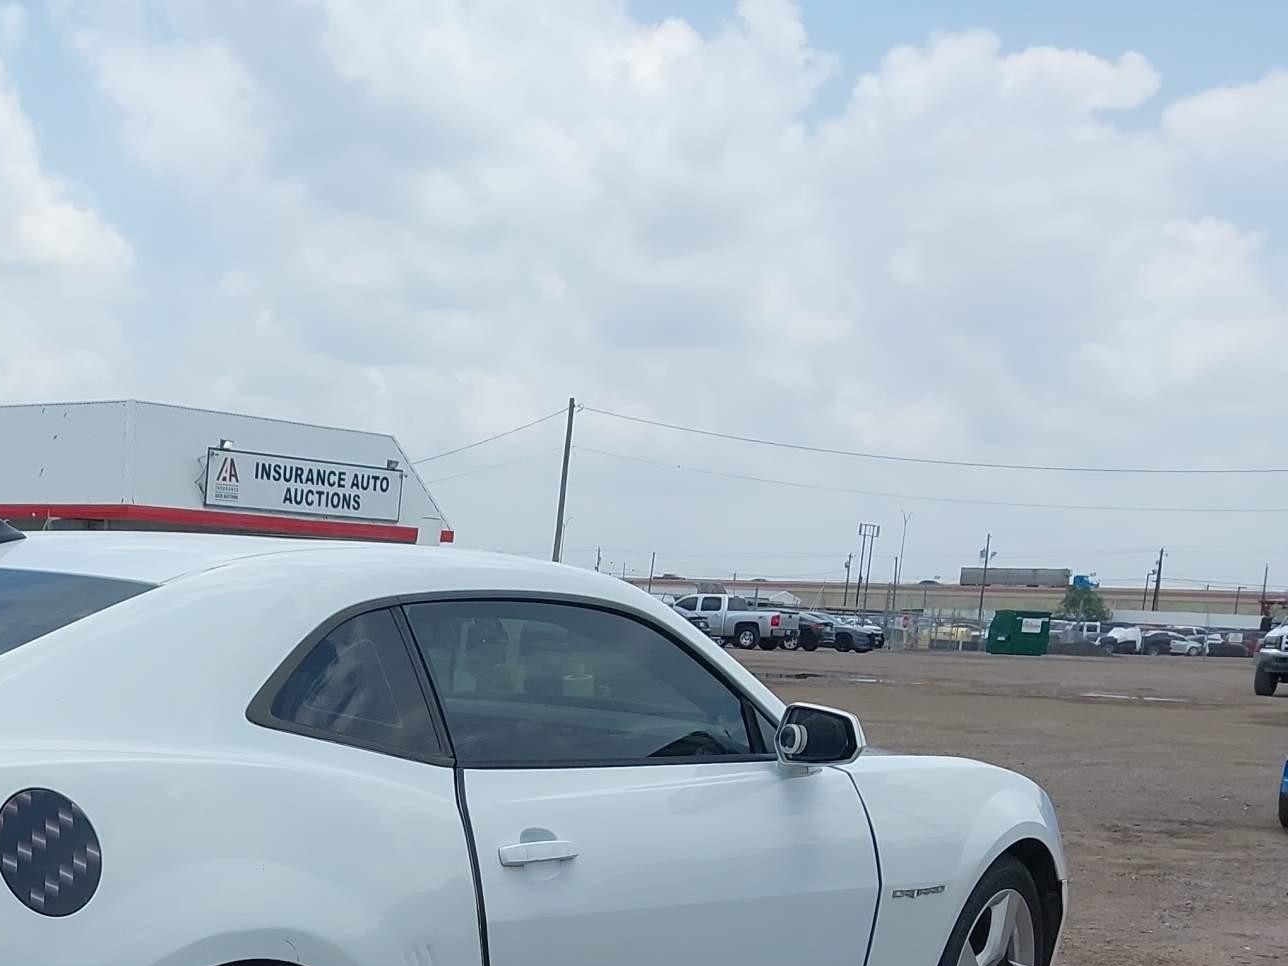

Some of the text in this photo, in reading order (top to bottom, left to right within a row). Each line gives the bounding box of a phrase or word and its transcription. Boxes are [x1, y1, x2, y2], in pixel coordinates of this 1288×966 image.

[254, 462, 390, 493] INSURANCE AUTO
[282, 487, 361, 511] AUCTIONS
